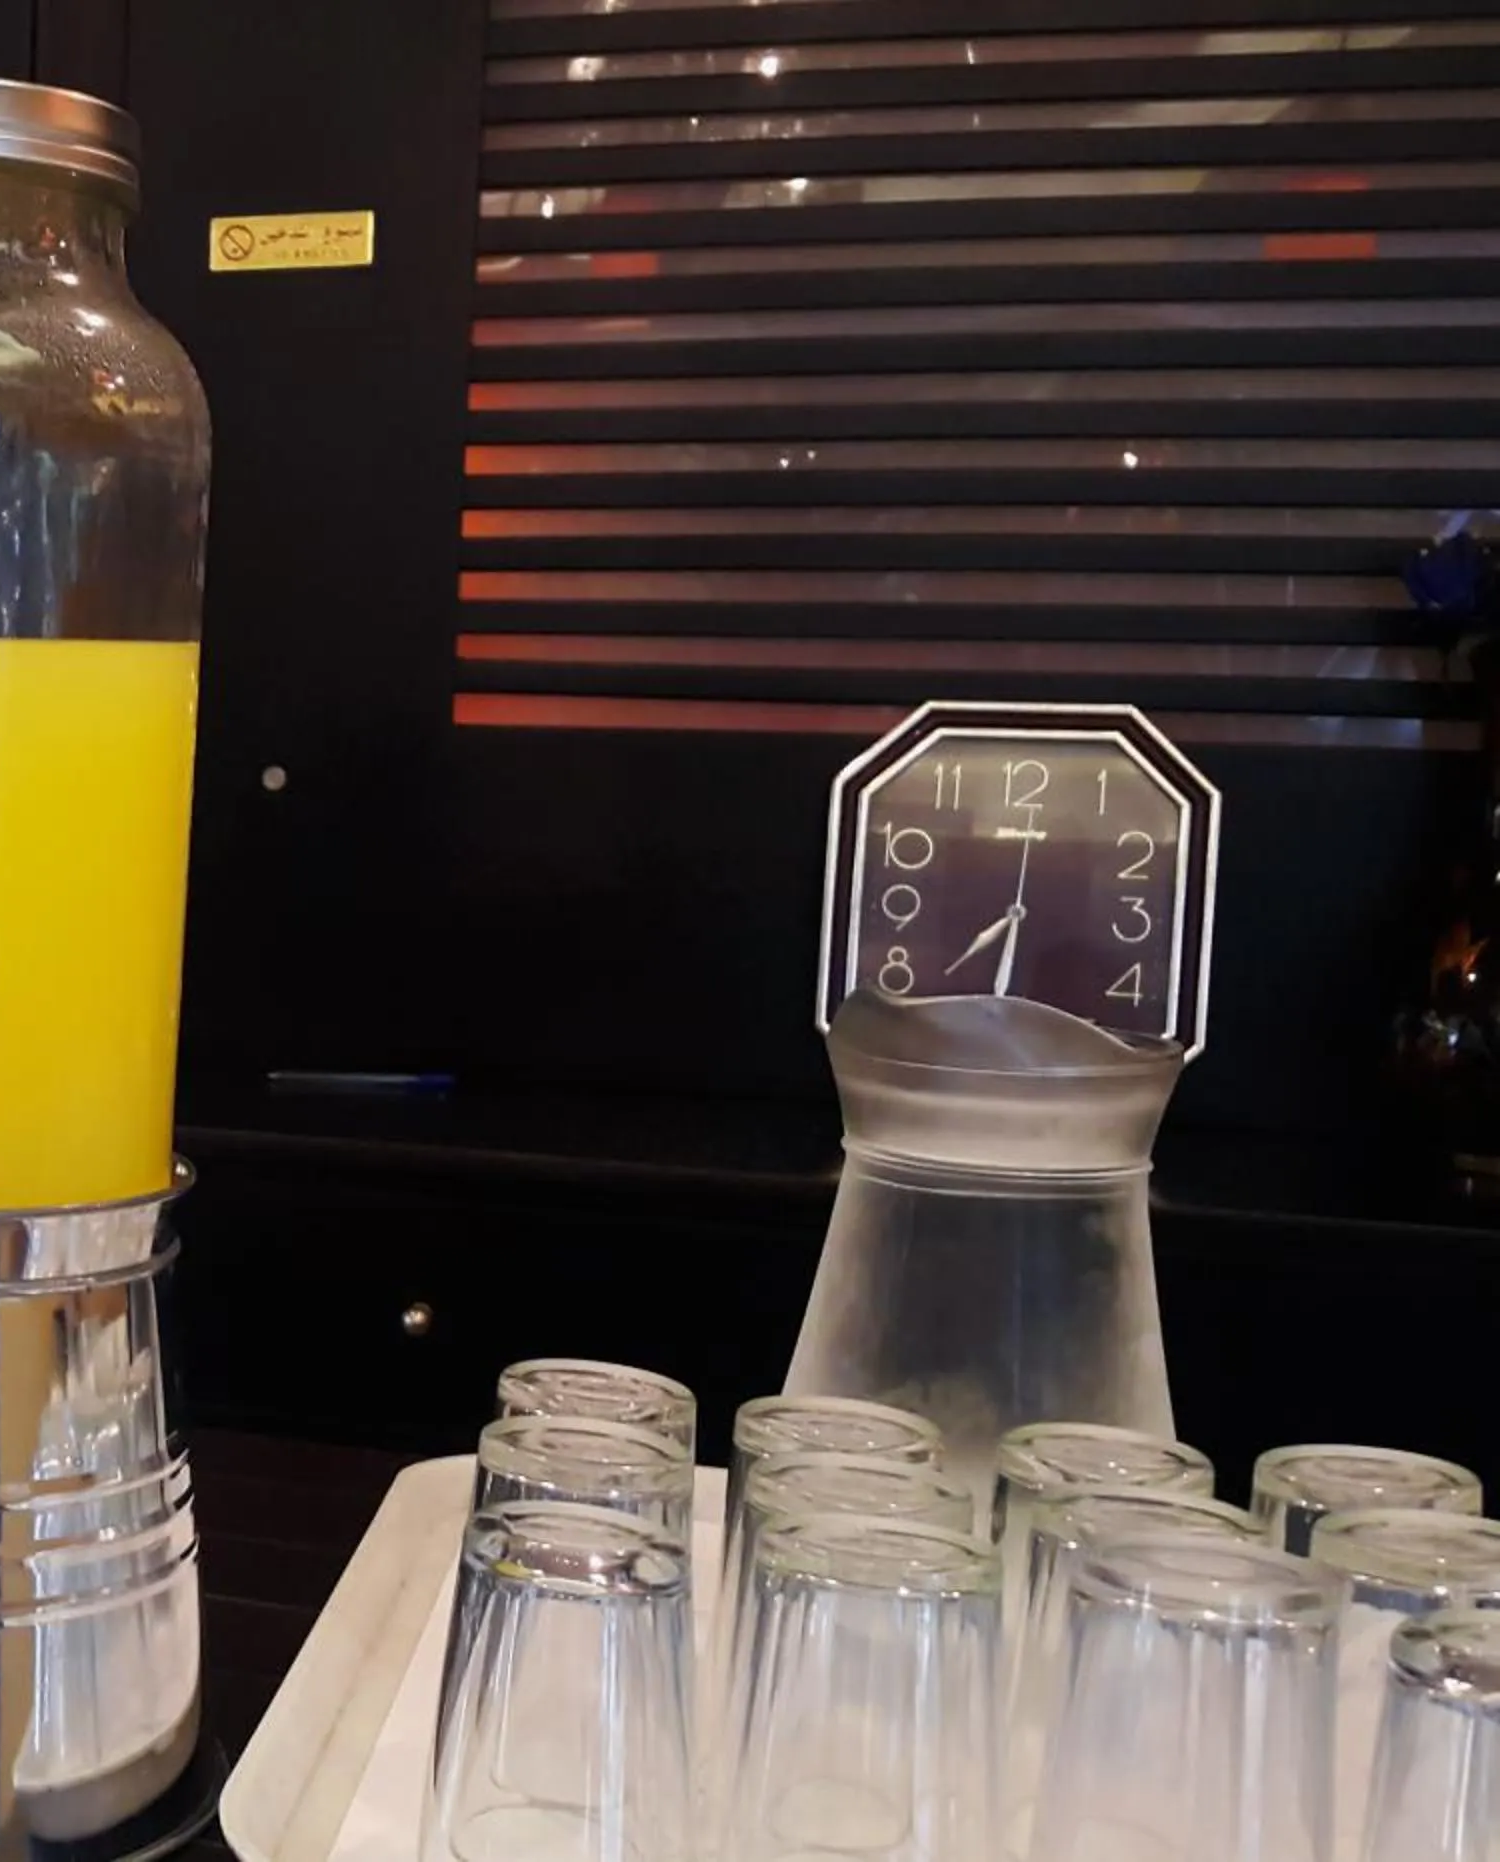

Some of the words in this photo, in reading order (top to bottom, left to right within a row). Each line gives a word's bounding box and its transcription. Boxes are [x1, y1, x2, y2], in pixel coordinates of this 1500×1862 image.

[933, 762, 962, 811] 11
[1003, 760, 1049, 807] 12
[1097, 768, 1108, 815] 1
[883, 821, 933, 869] 10
[1116, 831, 1155, 880] 2
[882, 884, 921, 931] 9
[1112, 896, 1151, 943] 3
[878, 946, 914, 995] 8
[1105, 962, 1143, 1006] 4
